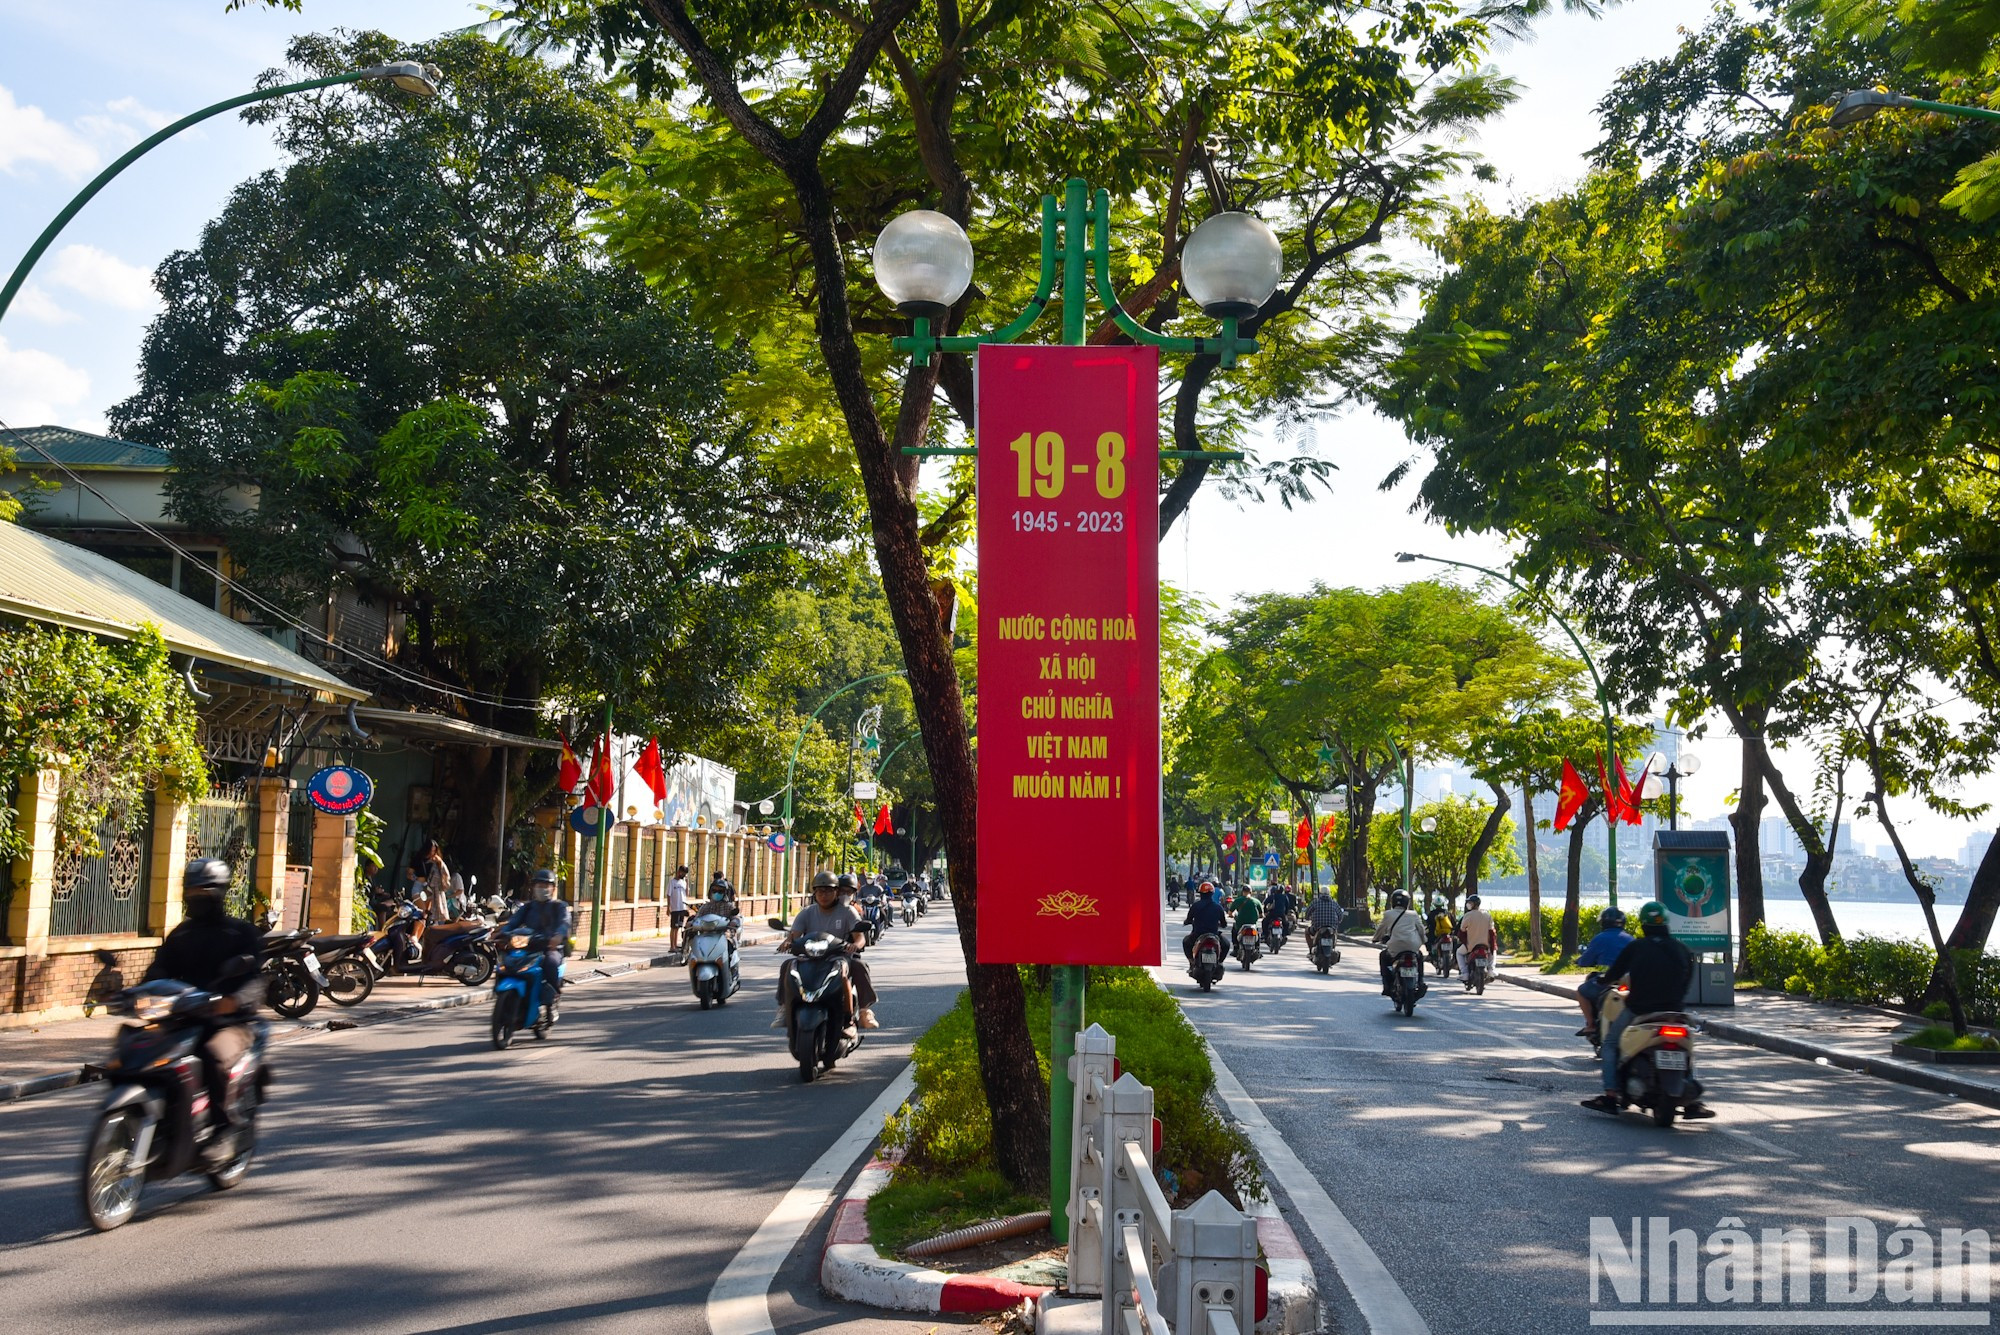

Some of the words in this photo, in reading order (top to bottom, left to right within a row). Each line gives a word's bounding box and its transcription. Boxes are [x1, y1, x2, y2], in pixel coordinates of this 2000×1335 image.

[1010, 431, 1126, 499] 19-8
[1011, 511, 1058, 533] 1945
[1076, 511, 1124, 533] 2023
[998, 614, 1046, 641] NƯỚC
[1050, 613, 1097, 643] CỘNG
[1102, 614, 1137, 641] HOÀ
[1039, 653, 1063, 680] XÃ
[1067, 653, 1096, 684] HỘI
[1021, 689, 1056, 719] CHỦ
[1060, 692, 1114, 720] NGHĨA
[1027, 731, 1063, 763] VIỆT
[1067, 735, 1108, 760] NAM
[1013, 770, 1065, 799] MUÔN
[1069, 772, 1110, 799] NĂM
